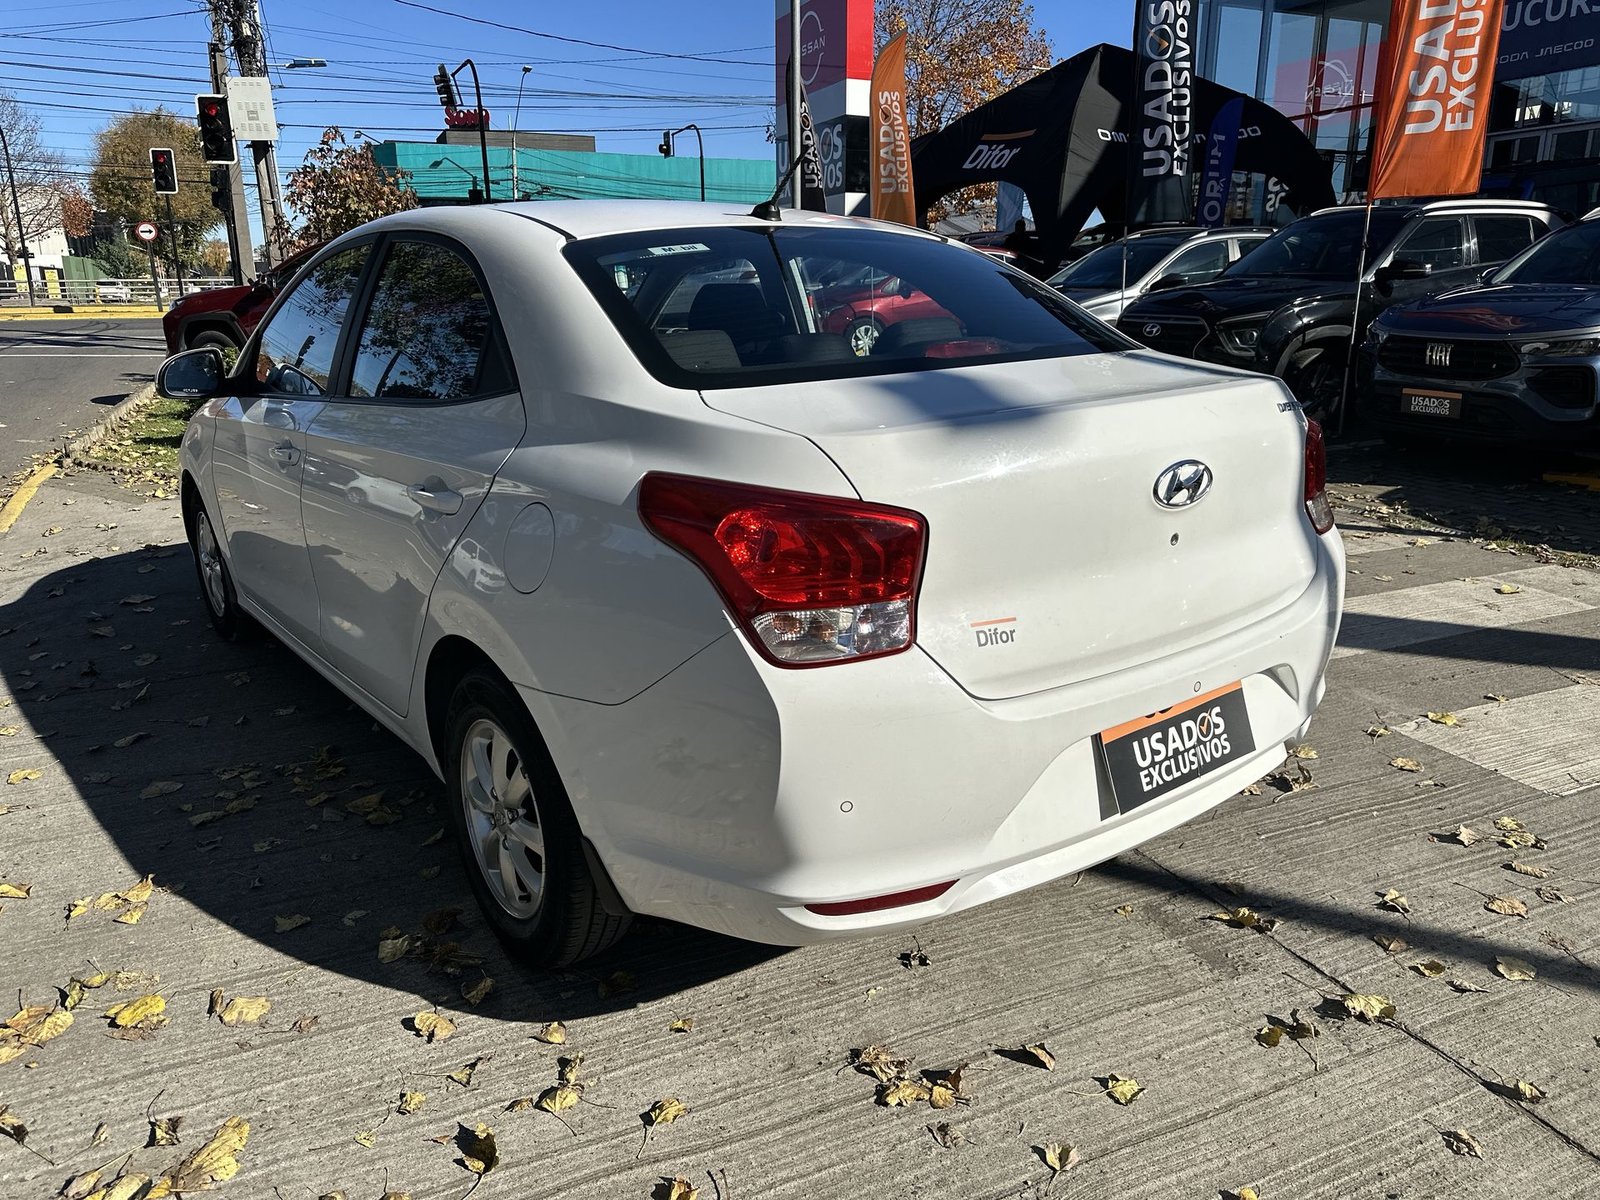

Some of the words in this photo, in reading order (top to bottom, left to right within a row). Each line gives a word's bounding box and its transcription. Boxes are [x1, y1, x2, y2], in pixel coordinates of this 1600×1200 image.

[1501, 0, 1600, 32] UCUR
[801, 35, 826, 57] SSAN
[1535, 38, 1595, 57] JAECOO
[1143, 3, 1175, 177] USADOS
[1172, 0, 1191, 177] EXCLUSIVOS
[879, 91, 897, 194] USADOS
[891, 91, 909, 193] EXCLUSIVOS
[962, 144, 1021, 169] Difor
[1425, 342, 1455, 367] FIAT
[1410, 405, 1450, 416] EXCLUSIVOS
[1411, 396, 1450, 409] USADOS
[975, 627, 1016, 648] Difor
[1132, 706, 1226, 768] USADOS
[1139, 733, 1231, 792] EXCLUSIVOS
